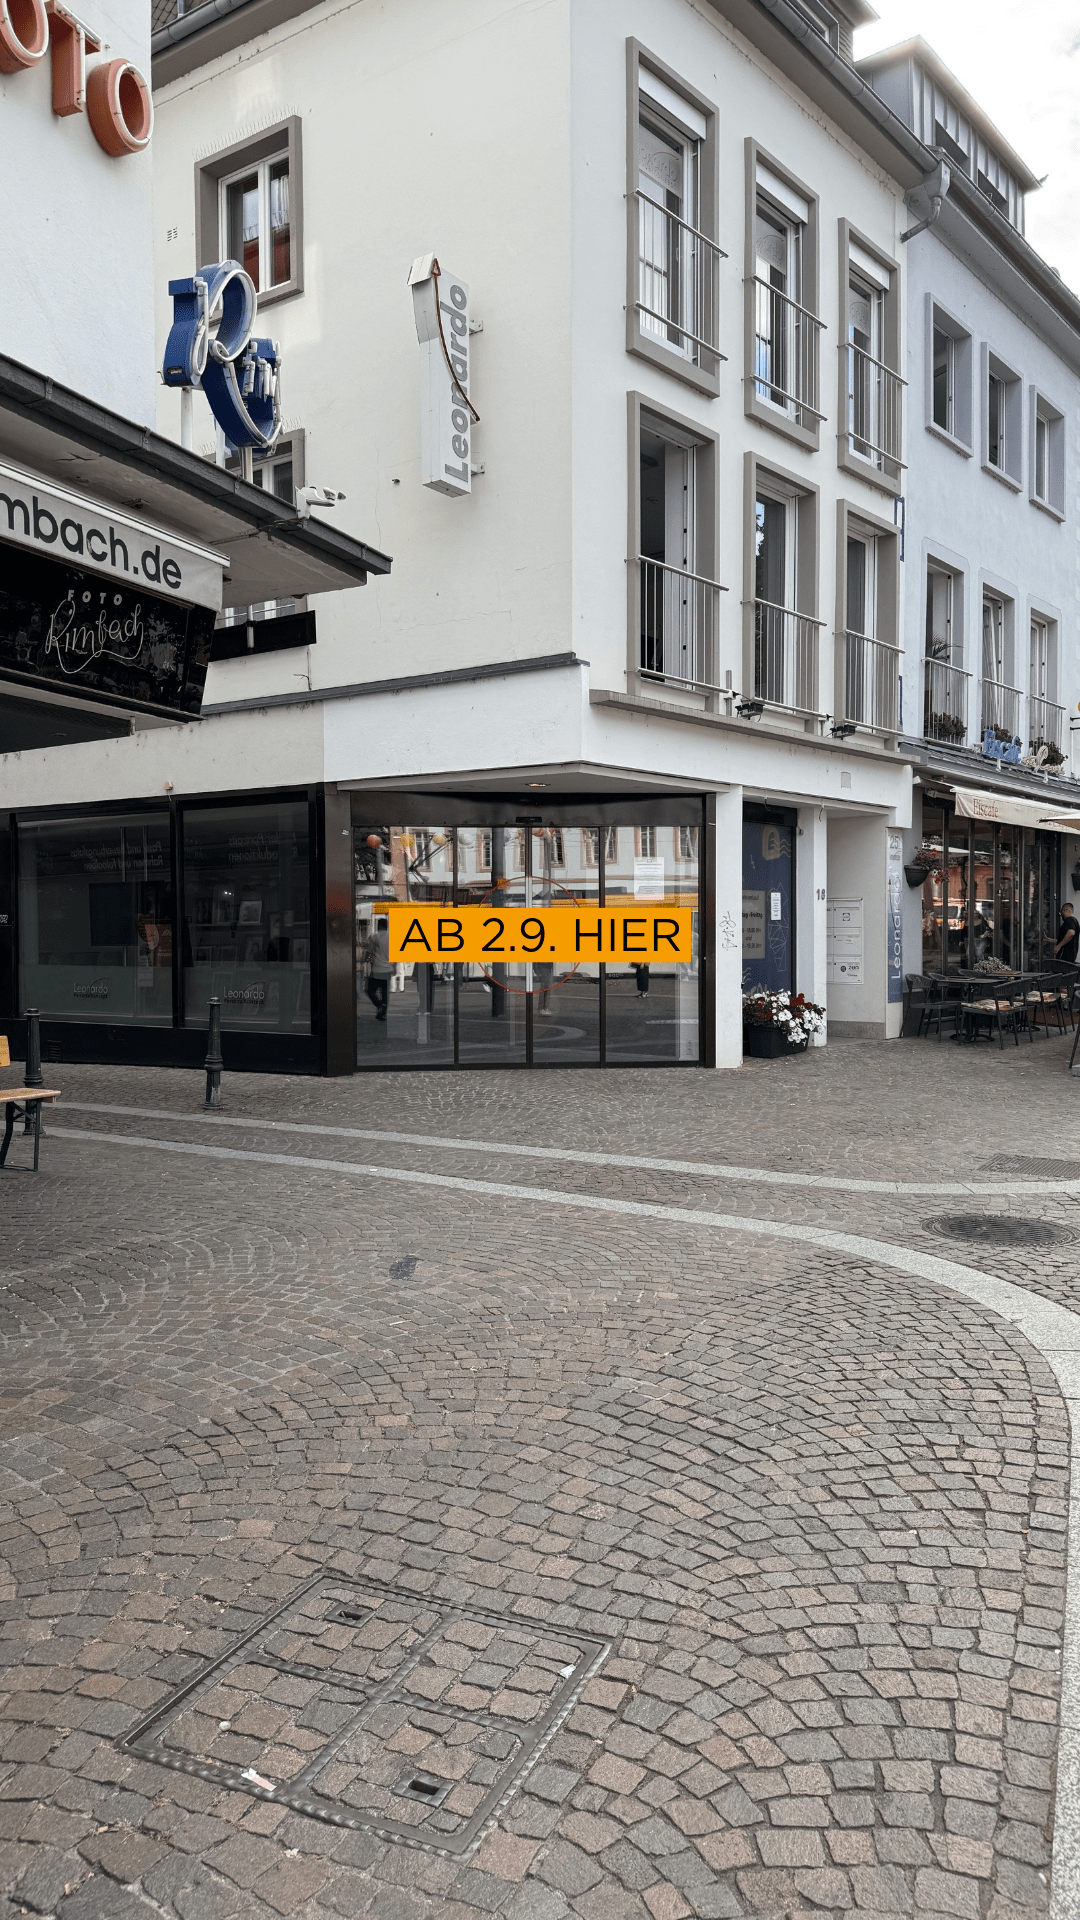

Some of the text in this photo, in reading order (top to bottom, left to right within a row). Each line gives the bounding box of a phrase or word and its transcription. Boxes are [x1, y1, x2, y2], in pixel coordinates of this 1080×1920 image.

[440, 284, 469, 483] Leonardo
[67, 589, 123, 606] FOTO
[816, 888, 826, 901] 18
[891, 876, 901, 979] Leonardo
[73, 982, 109, 994] Leonardo
[223, 986, 265, 999] Leonardo
